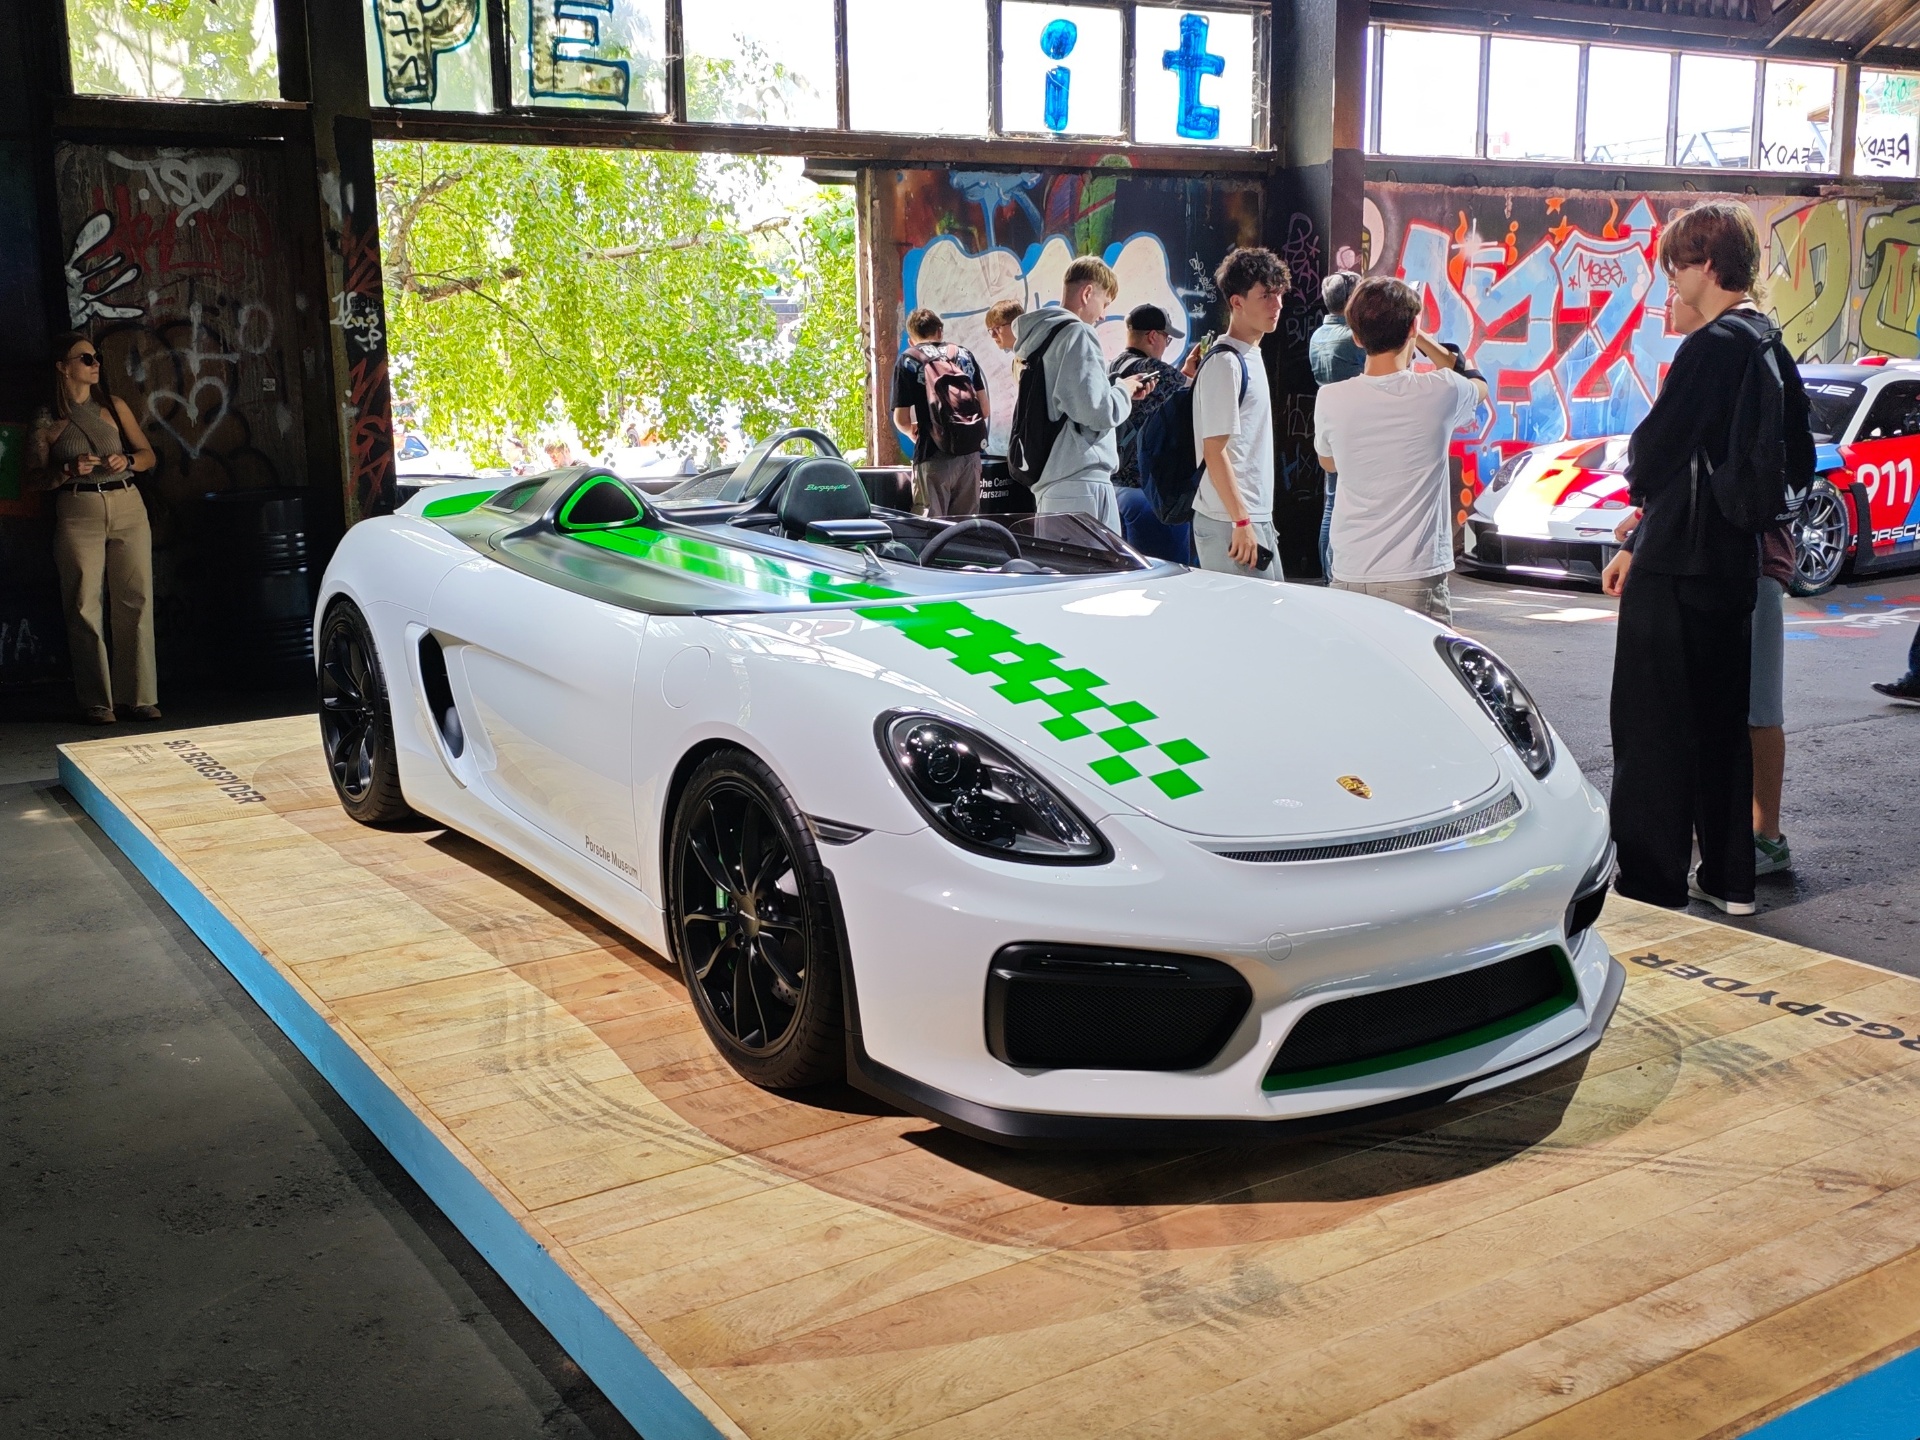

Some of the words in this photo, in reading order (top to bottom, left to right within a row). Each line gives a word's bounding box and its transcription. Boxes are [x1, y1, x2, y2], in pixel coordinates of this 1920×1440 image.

[1856, 458, 1913, 506] 911
[178, 751, 268, 805] BERGSPYDER
[585, 834, 611, 862] Porsche
[610, 850, 639, 881] Museum
